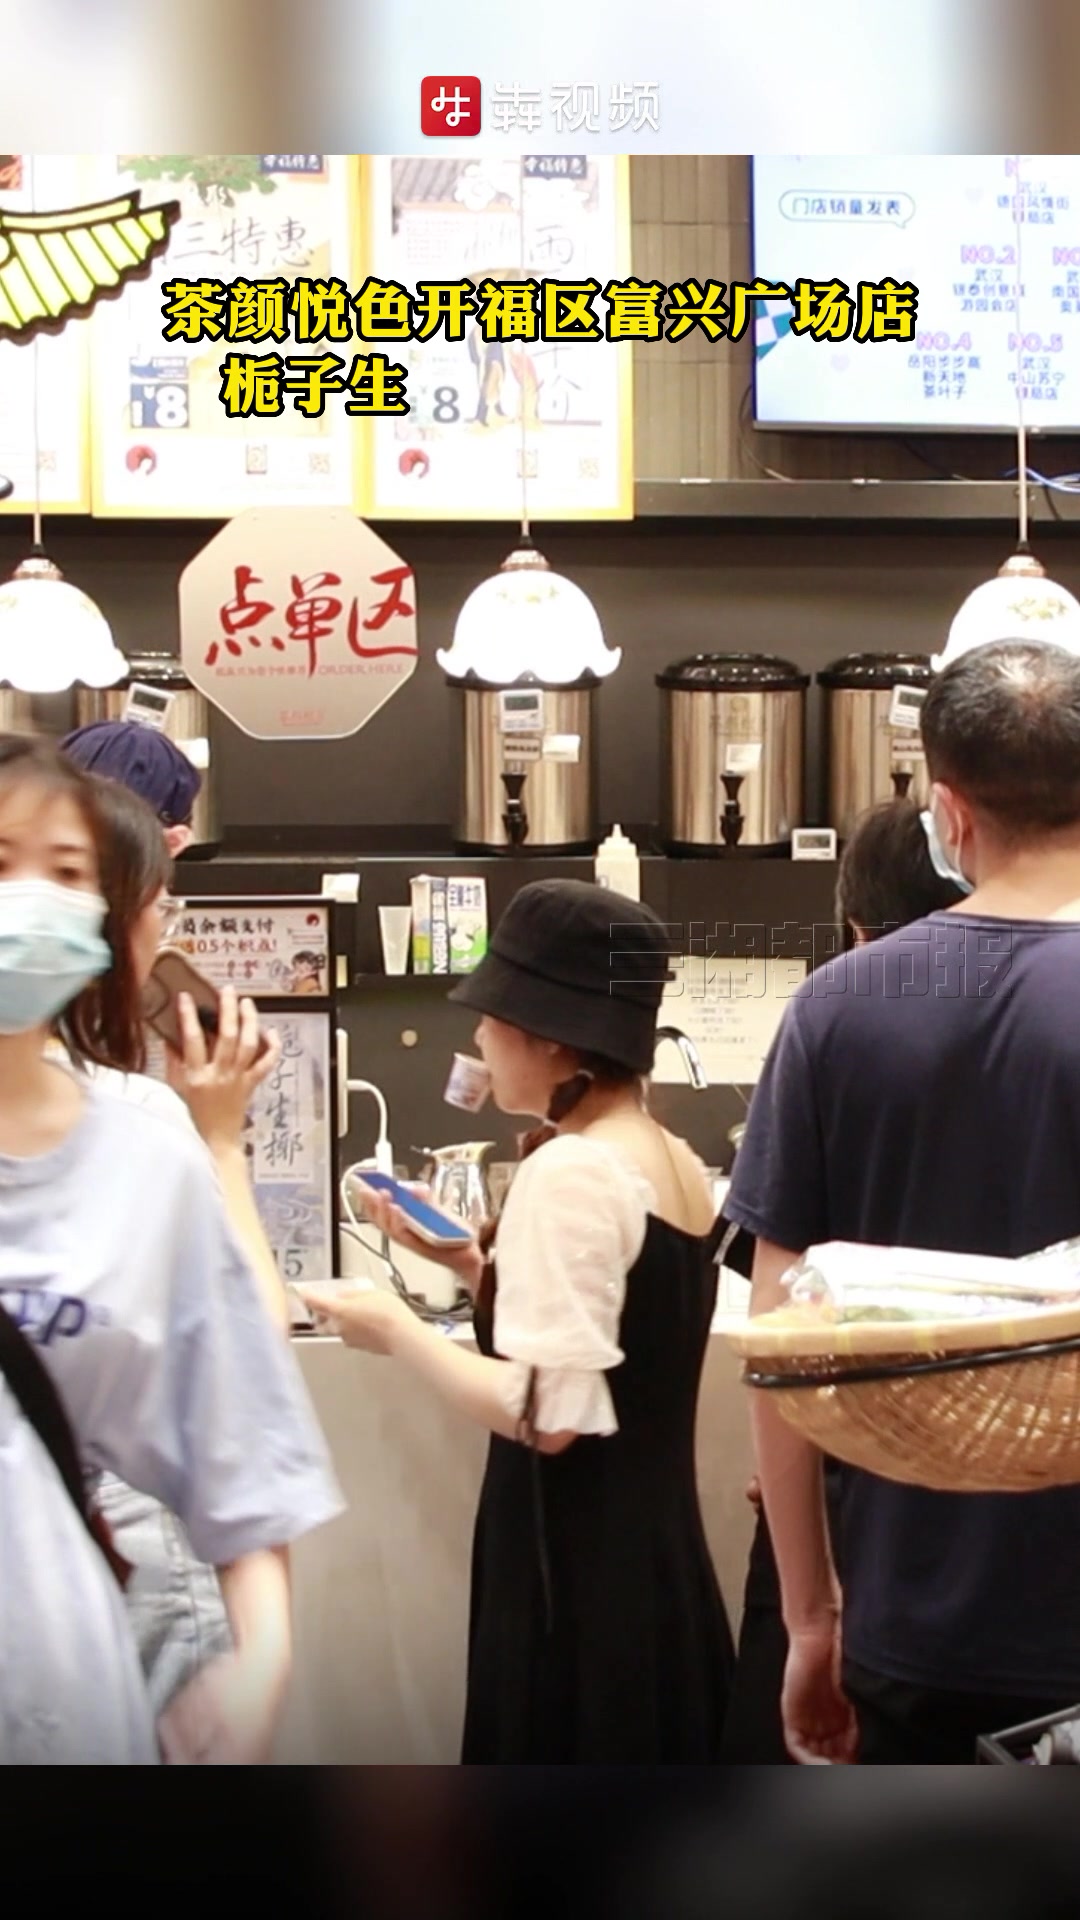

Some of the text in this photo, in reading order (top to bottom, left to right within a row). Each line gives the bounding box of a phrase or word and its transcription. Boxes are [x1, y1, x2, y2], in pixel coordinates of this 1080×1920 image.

[792, 197, 901, 216] 门店销量发表
[204, 565, 419, 679] 点单区
[318, 664, 366, 676] ORDER
[369, 663, 404, 675] HERE
